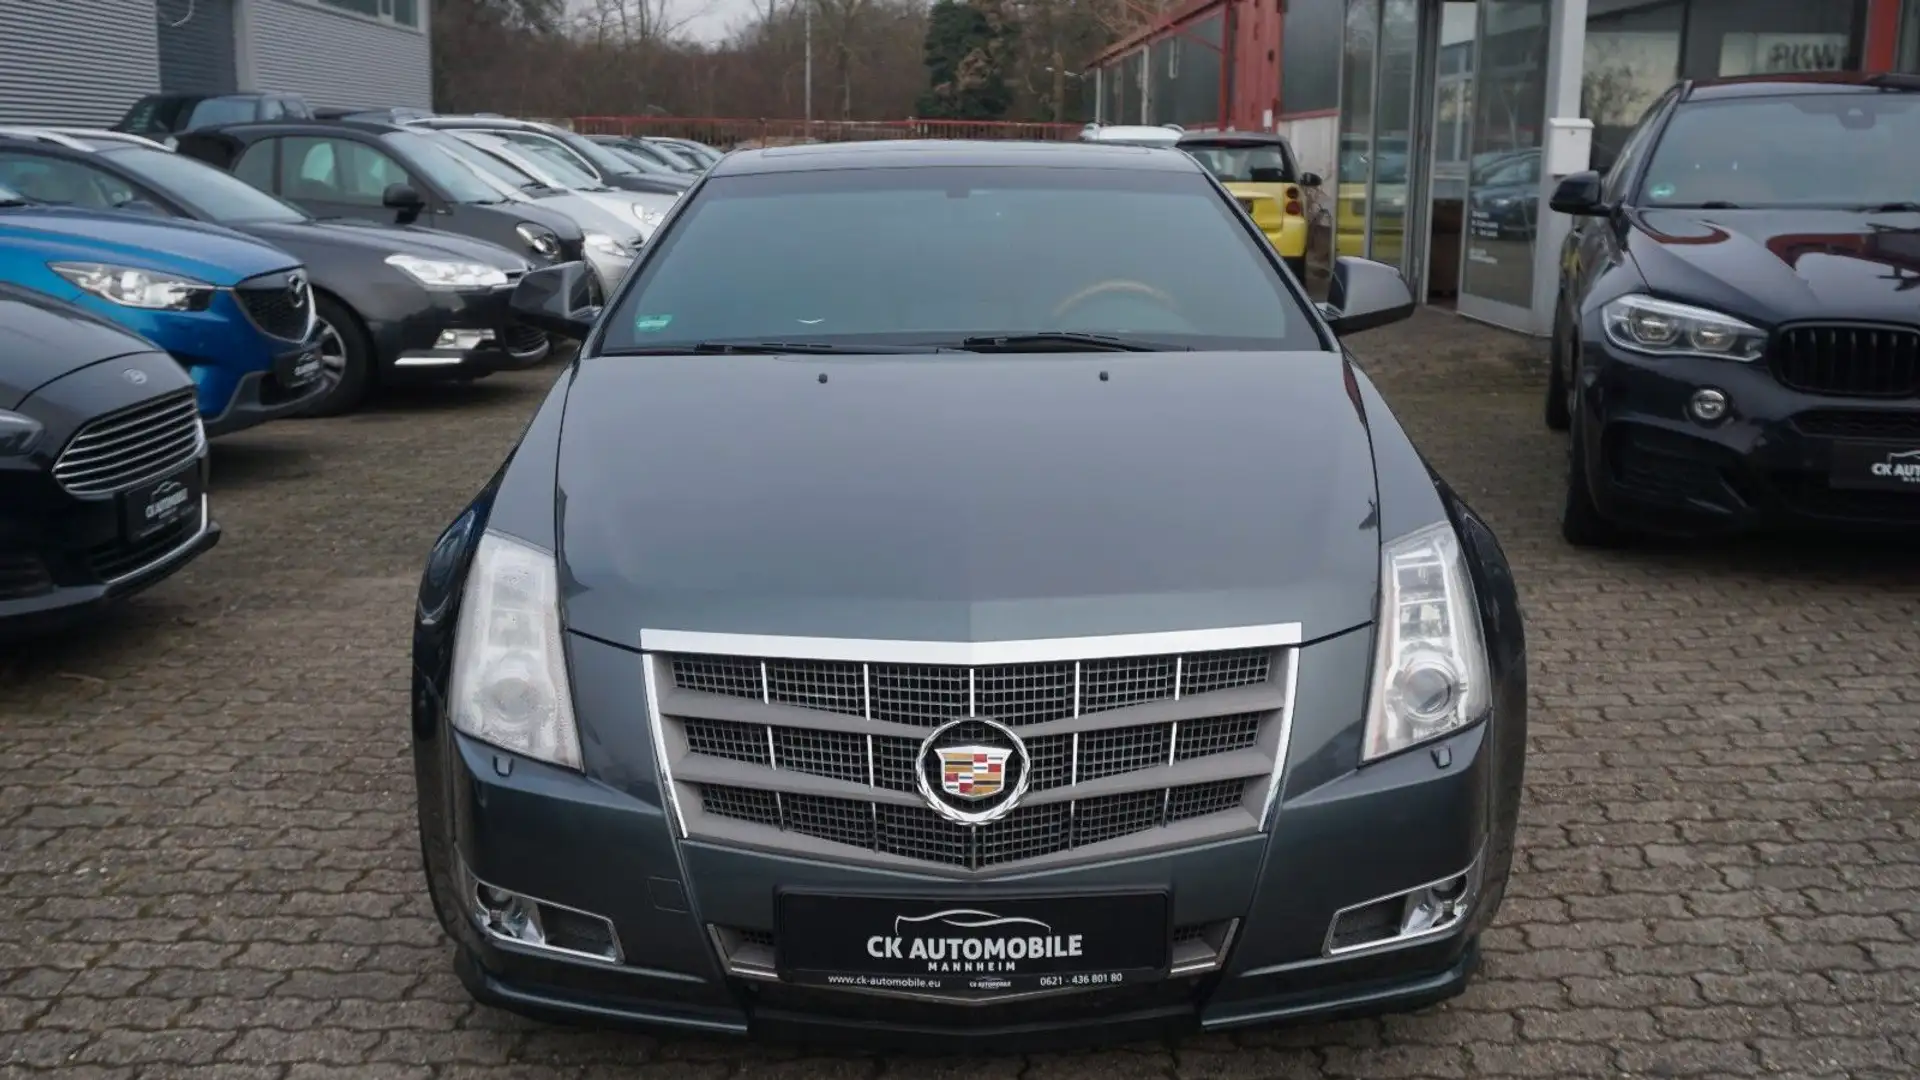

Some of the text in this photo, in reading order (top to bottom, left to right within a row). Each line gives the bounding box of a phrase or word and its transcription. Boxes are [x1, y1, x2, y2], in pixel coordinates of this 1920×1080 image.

[866, 934, 1083, 960] CK AUTOMOBILE
[927, 961, 1016, 972] MANNHEIM
[827, 975, 941, 988] www.ck-automobile.eu
[1040, 975, 1063, 986] 0621
[1071, 974, 1090, 984] 436
[1091, 973, 1108, 983] 801
[1110, 972, 1123, 982] 80
